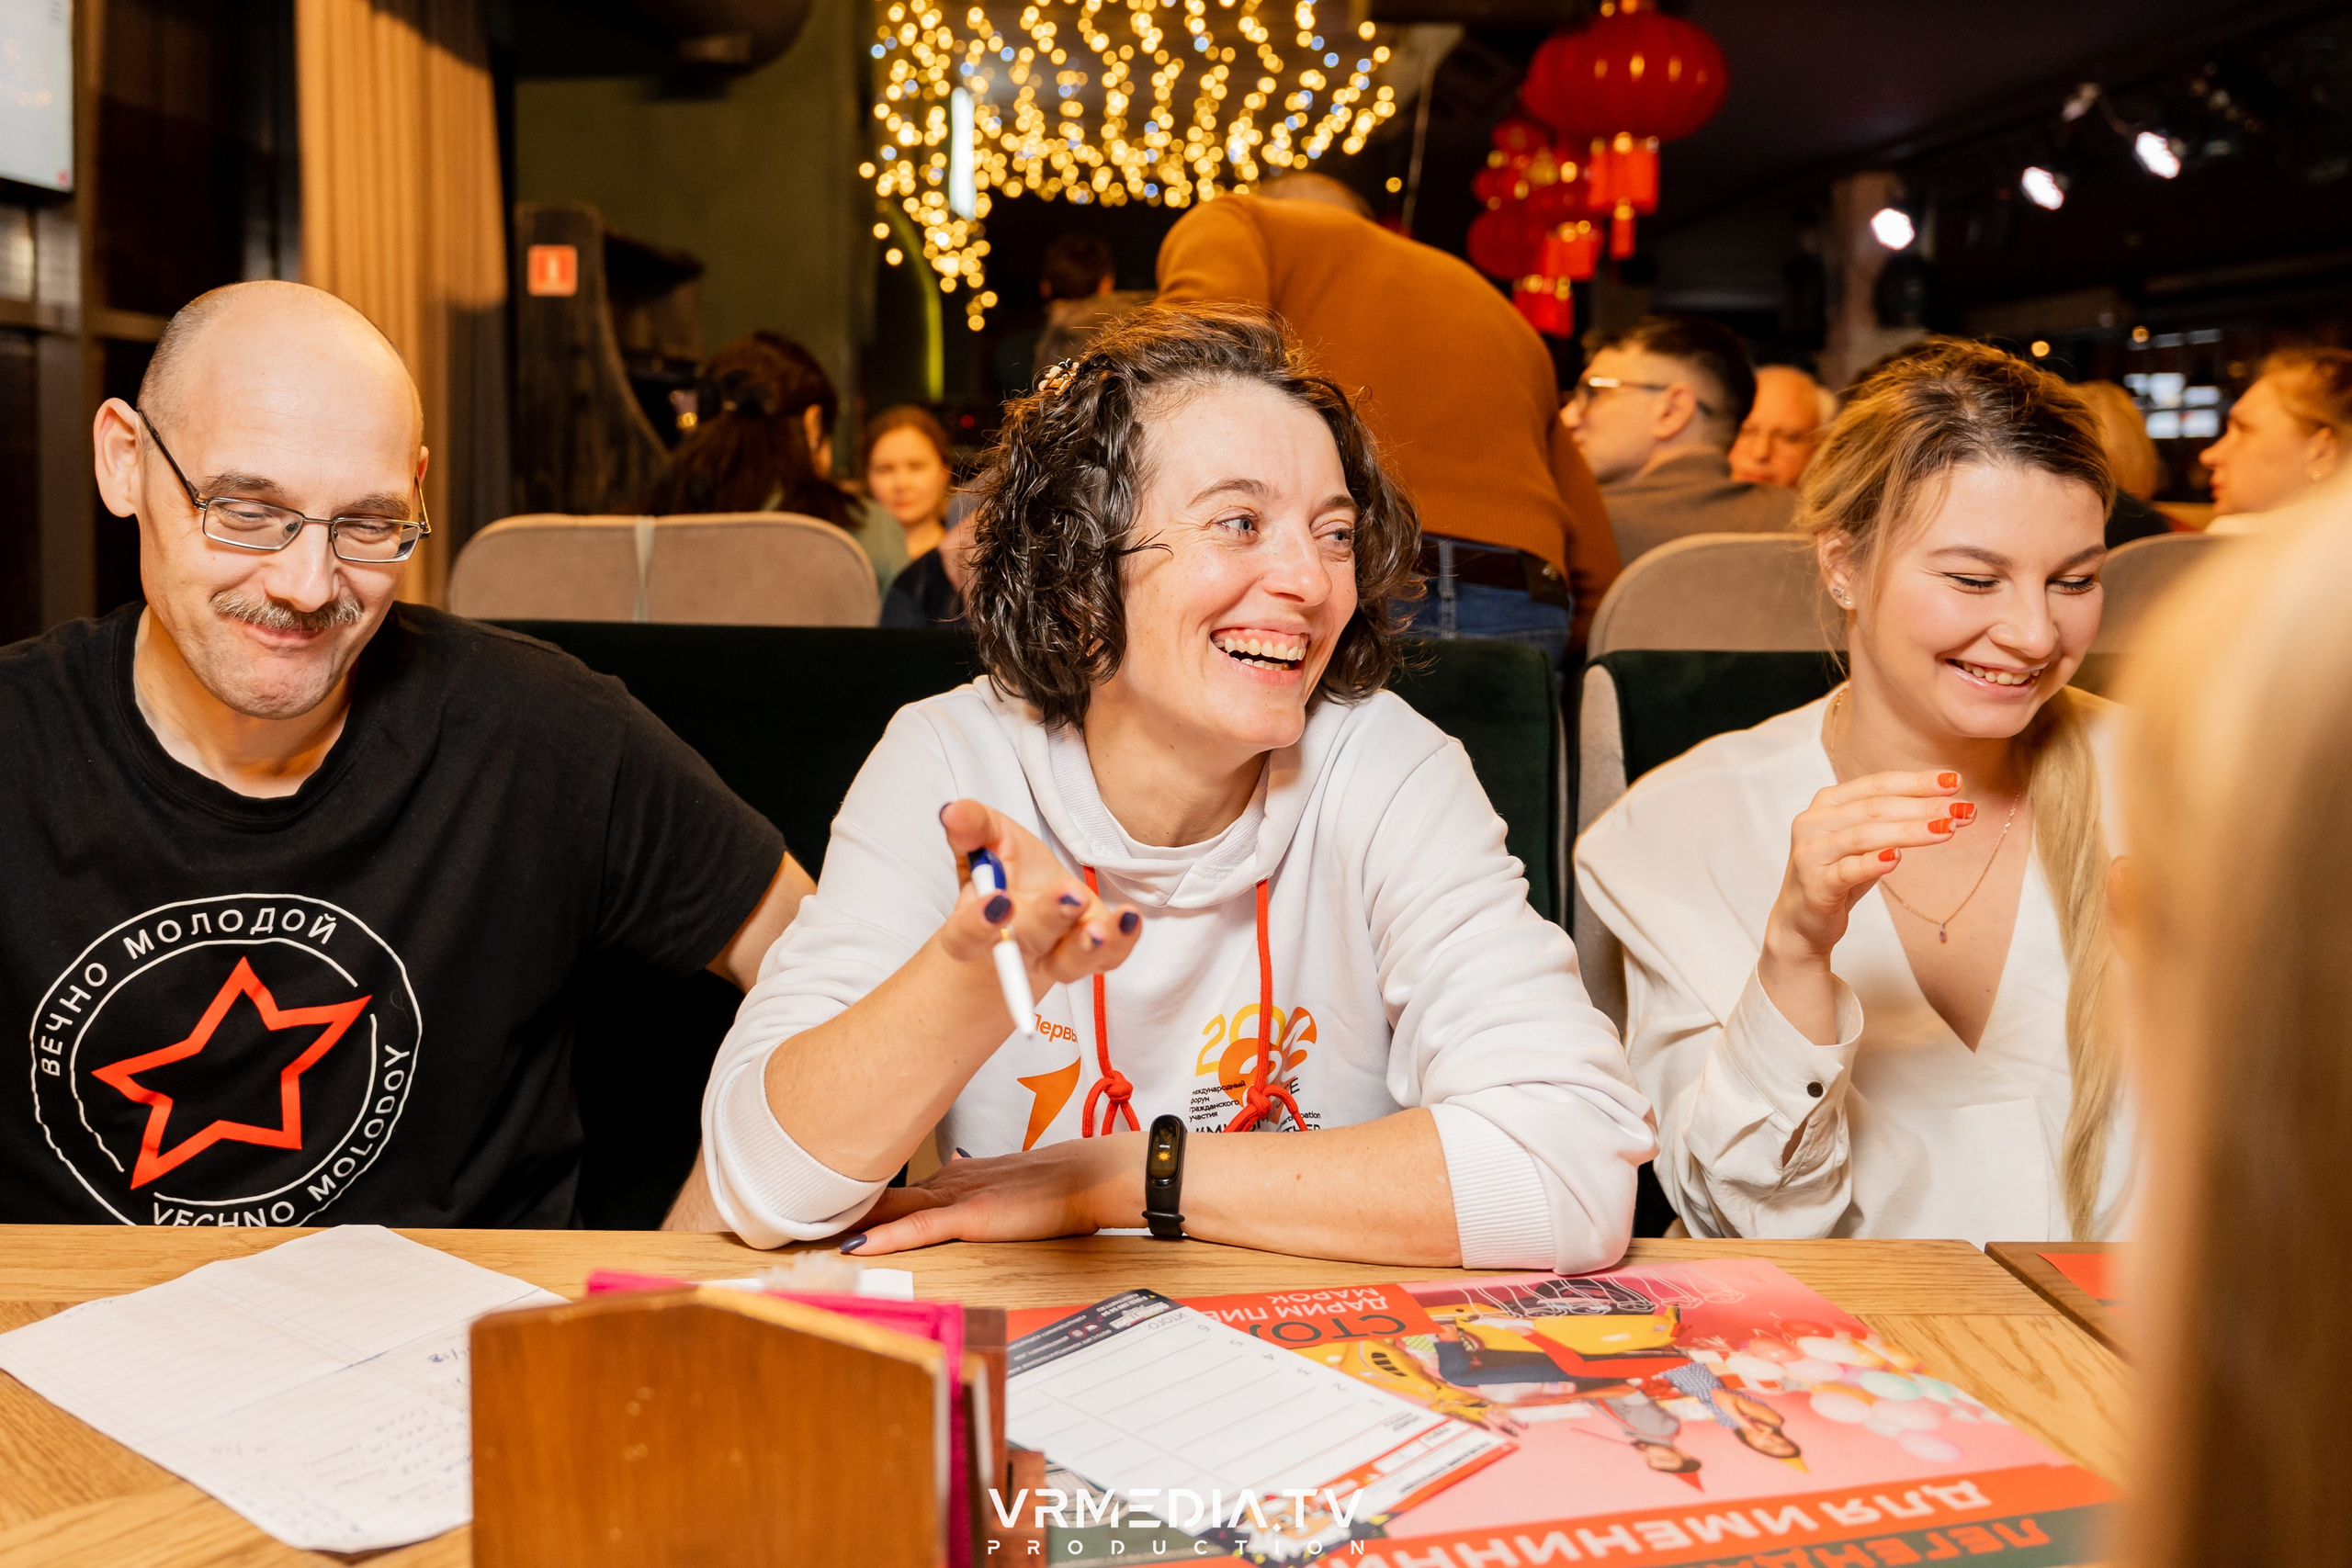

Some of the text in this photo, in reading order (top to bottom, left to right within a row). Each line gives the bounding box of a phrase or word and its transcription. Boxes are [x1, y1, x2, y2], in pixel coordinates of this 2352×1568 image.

[40, 907, 337, 1077] ВЕЧНО МОЛОДОЙ
[307, 1043, 411, 1202] MOLODOY
[1189, 1111, 1218, 1122] участия
[1266, 1287, 1380, 1304] МАРОК
[1274, 1295, 1389, 1318] ДАРИМ
[1818, 1480, 1993, 1527] ДЛЯ
